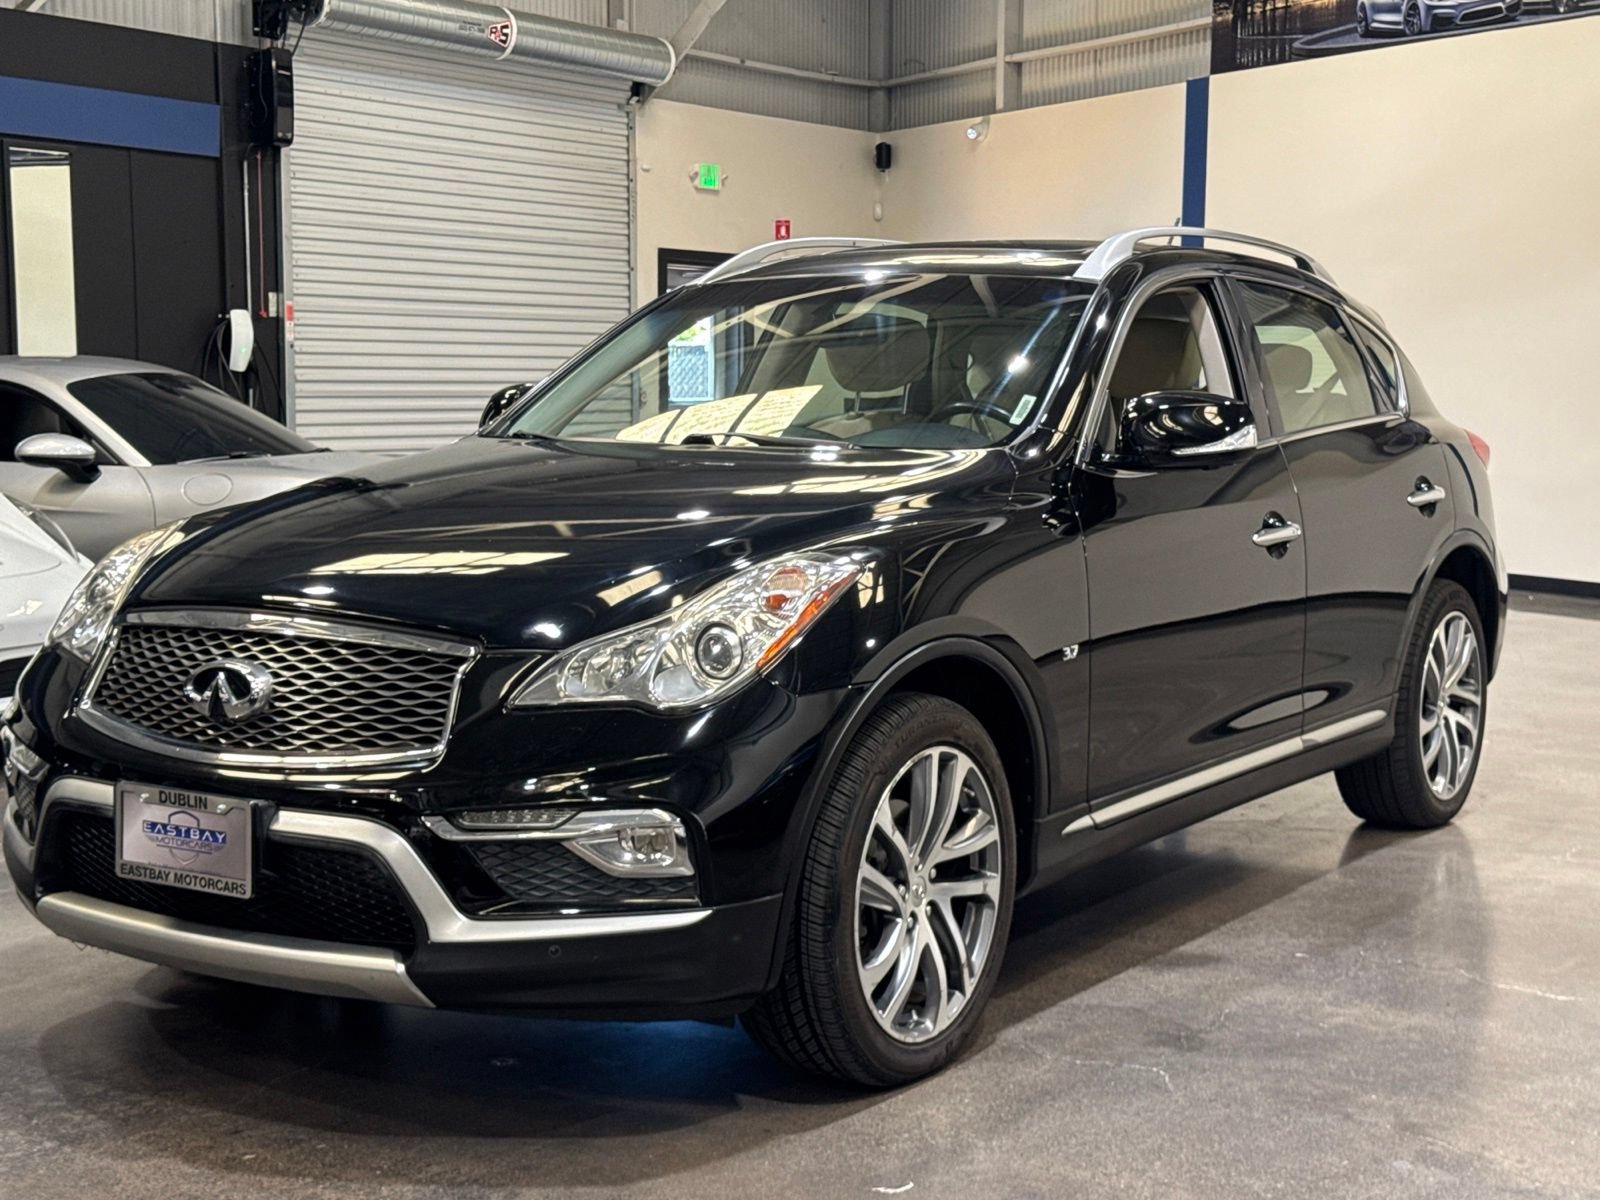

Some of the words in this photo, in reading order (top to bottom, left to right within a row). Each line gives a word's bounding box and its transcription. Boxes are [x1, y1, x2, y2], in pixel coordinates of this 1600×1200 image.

[158, 790, 208, 810] DUBLIN
[143, 821, 226, 844] EASTBAY
[156, 837, 213, 852] MOTORCARS
[120, 864, 171, 883] EASTBAY
[173, 872, 247, 896] MOTORCARS
